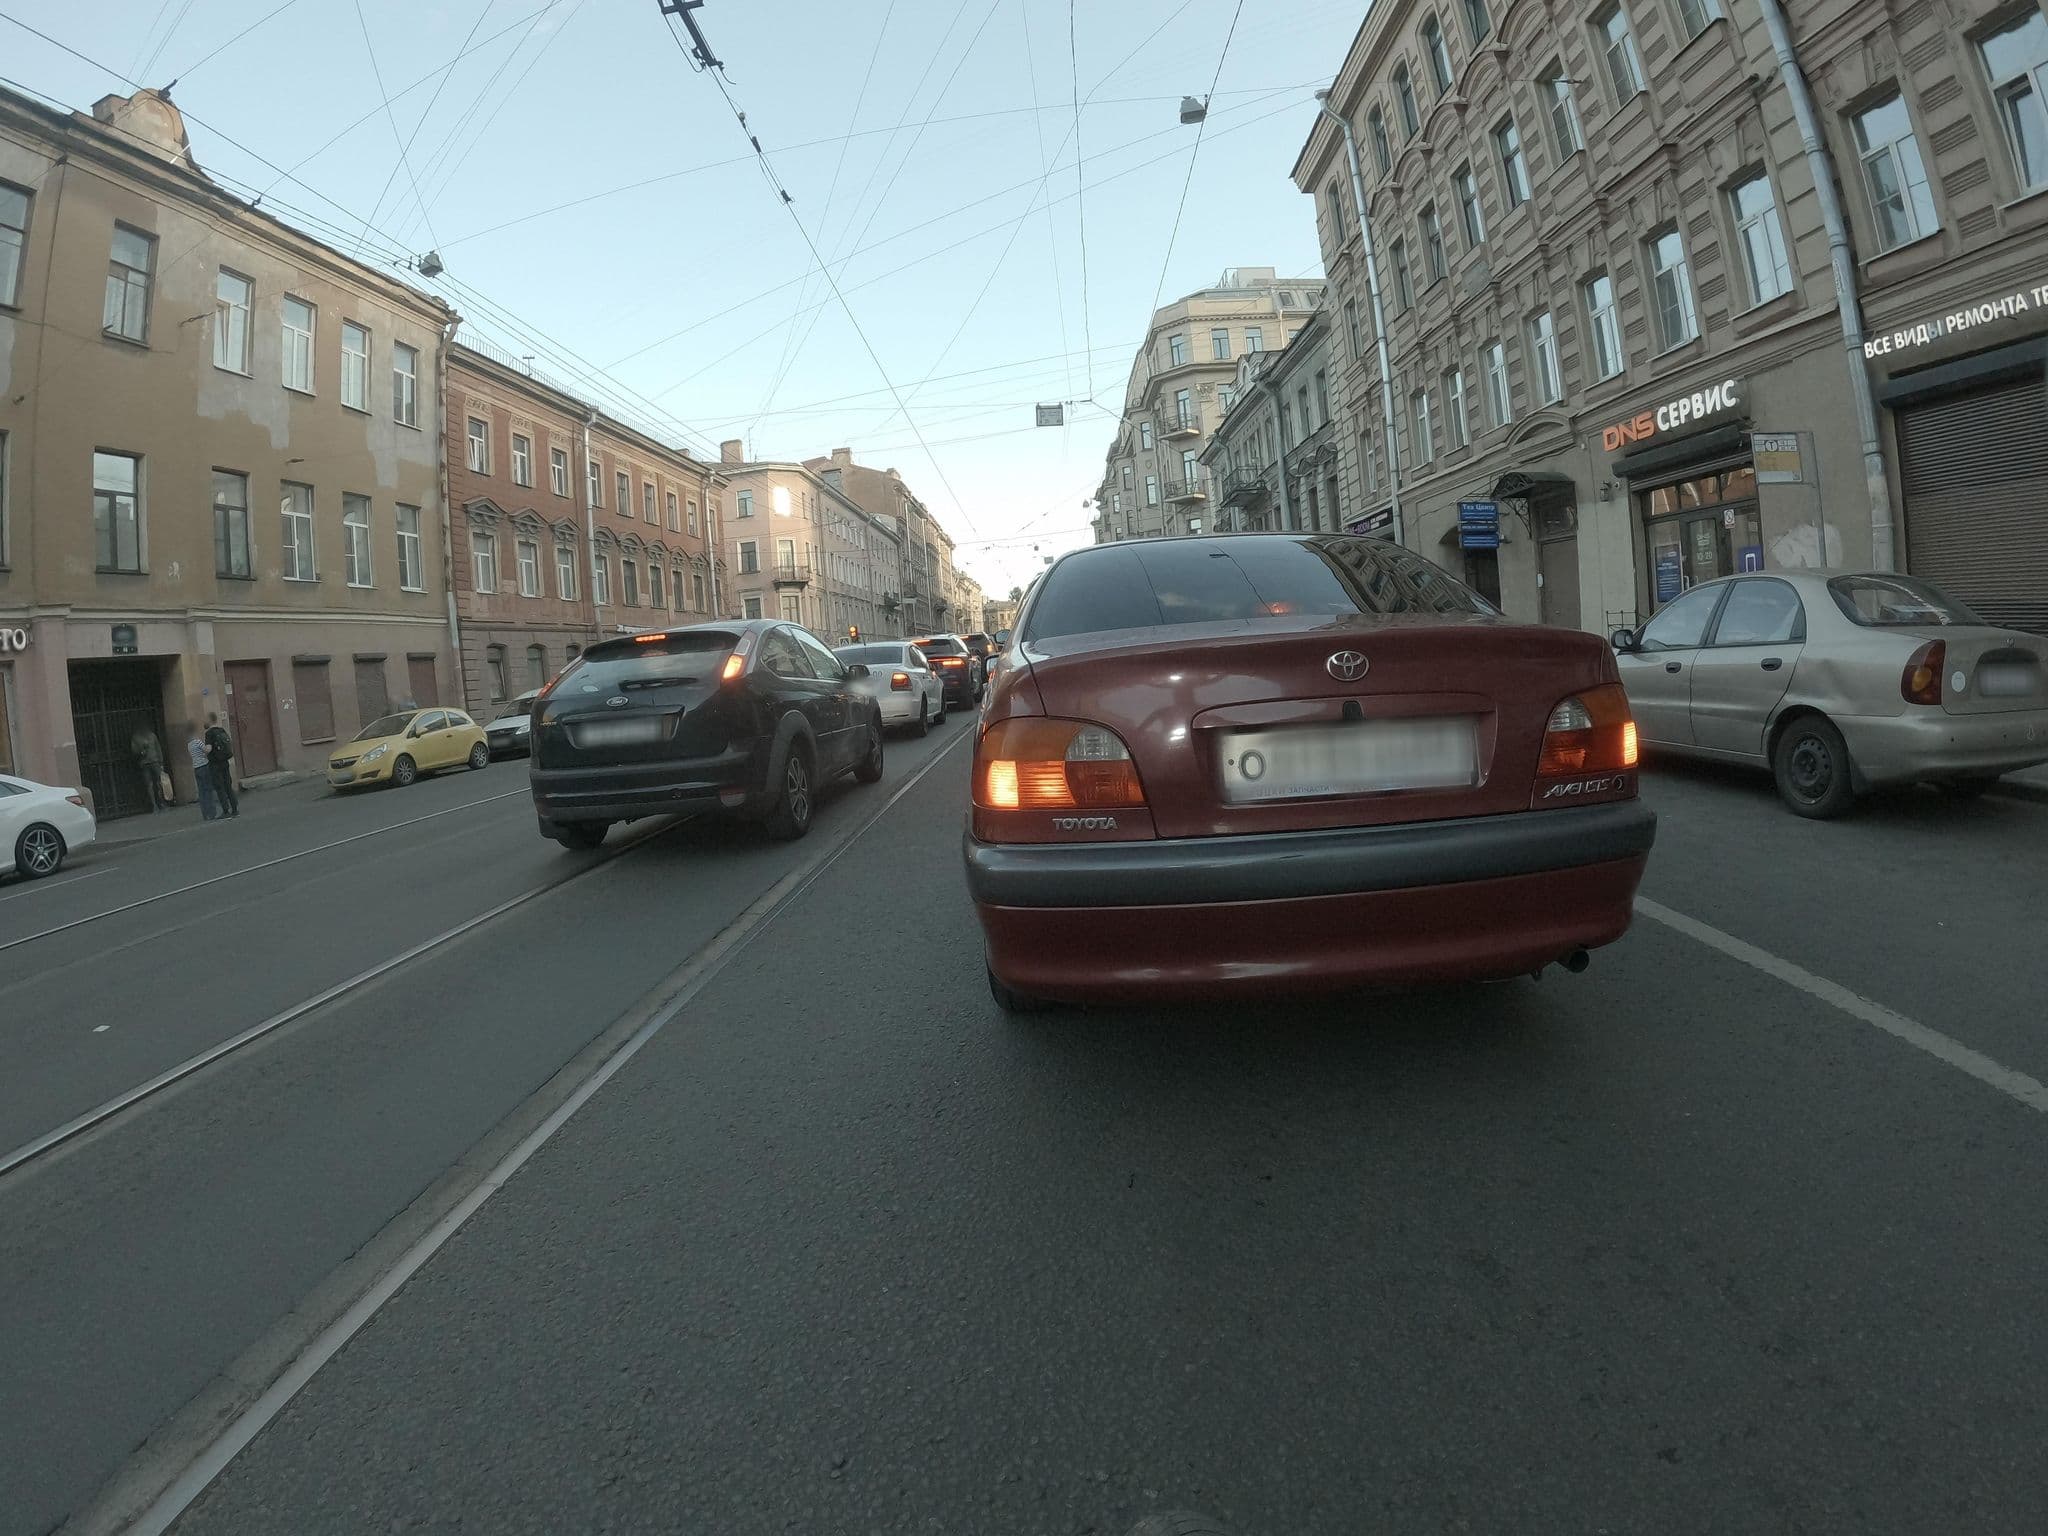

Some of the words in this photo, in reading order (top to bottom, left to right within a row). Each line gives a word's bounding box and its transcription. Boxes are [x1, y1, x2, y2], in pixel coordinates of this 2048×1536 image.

[1863, 336, 1892, 359] ВСЕ
[1894, 319, 1943, 349] ВИДЫ
[1945, 292, 2029, 333] РЕМОНТА
[1602, 410, 1655, 452] DNS
[1656, 379, 1737, 431] СЕРВИС
[0, 628, 27, 651] ТО
[1052, 817, 1119, 831] TOYOTA
